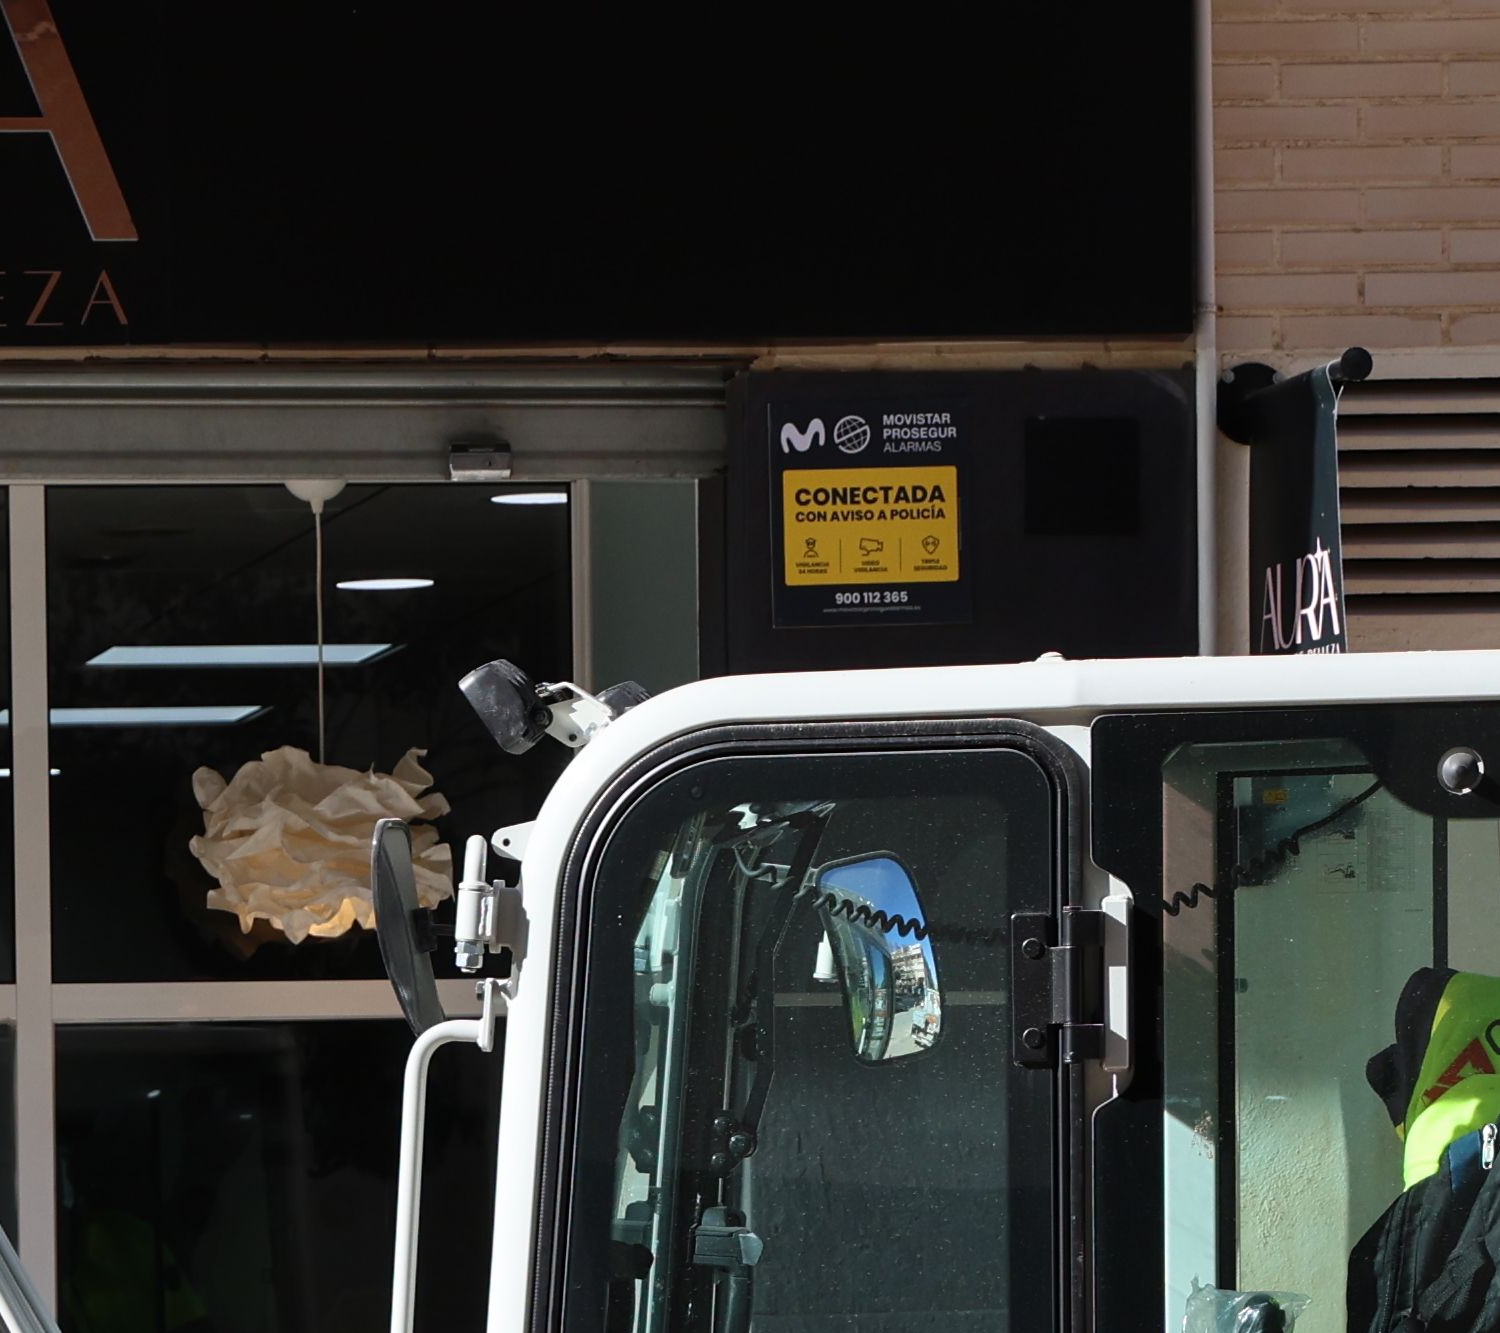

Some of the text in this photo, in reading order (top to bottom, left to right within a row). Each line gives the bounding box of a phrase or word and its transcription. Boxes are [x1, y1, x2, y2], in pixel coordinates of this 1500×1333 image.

[882, 413, 951, 426] MOVISTAR
[882, 427, 957, 440] PROSEGUR
[883, 441, 942, 453] ALARMAS
[794, 485, 946, 506] CONECTADA
[795, 504, 946, 523] CON AVISO A POLICÍA
[835, 591, 908, 605] 900 112 365
[1260, 549, 1340, 654] AURA
